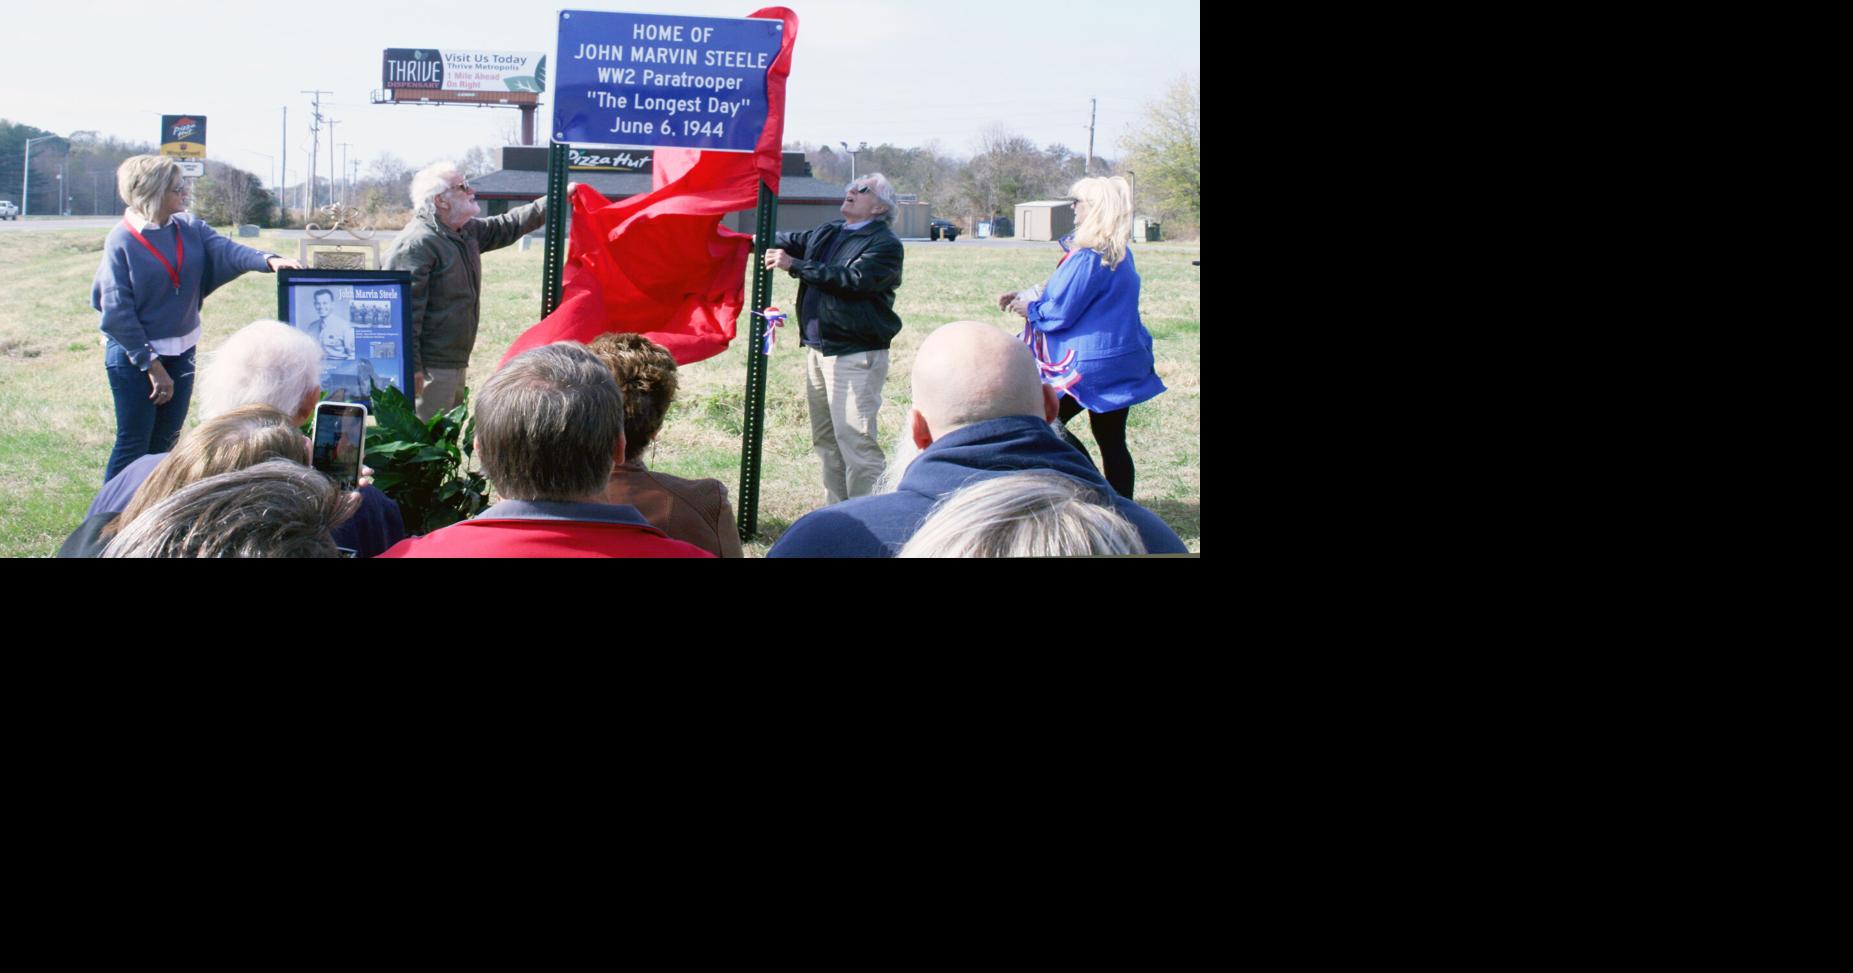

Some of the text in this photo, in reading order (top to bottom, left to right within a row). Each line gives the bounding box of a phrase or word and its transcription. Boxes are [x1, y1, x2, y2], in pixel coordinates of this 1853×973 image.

[633, 24, 714, 44] HOME OF
[445, 53, 527, 66] Visit Us Today
[574, 44, 769, 70] JOHN MARVIN STEELE
[387, 59, 441, 82] THRIVE
[454, 72, 472, 80] Mile
[475, 72, 500, 80] Ahead
[598, 67, 743, 92] WW2 Paratrooper
[387, 81, 440, 89] DISPENSARY
[459, 81, 480, 89] Right
[587, 91, 751, 118] "The Longest Day"
[610, 117, 724, 138] June 6, 1944
[568, 149, 653, 168] Pizza Hut
[338, 288, 398, 301] John Marvin Steele
